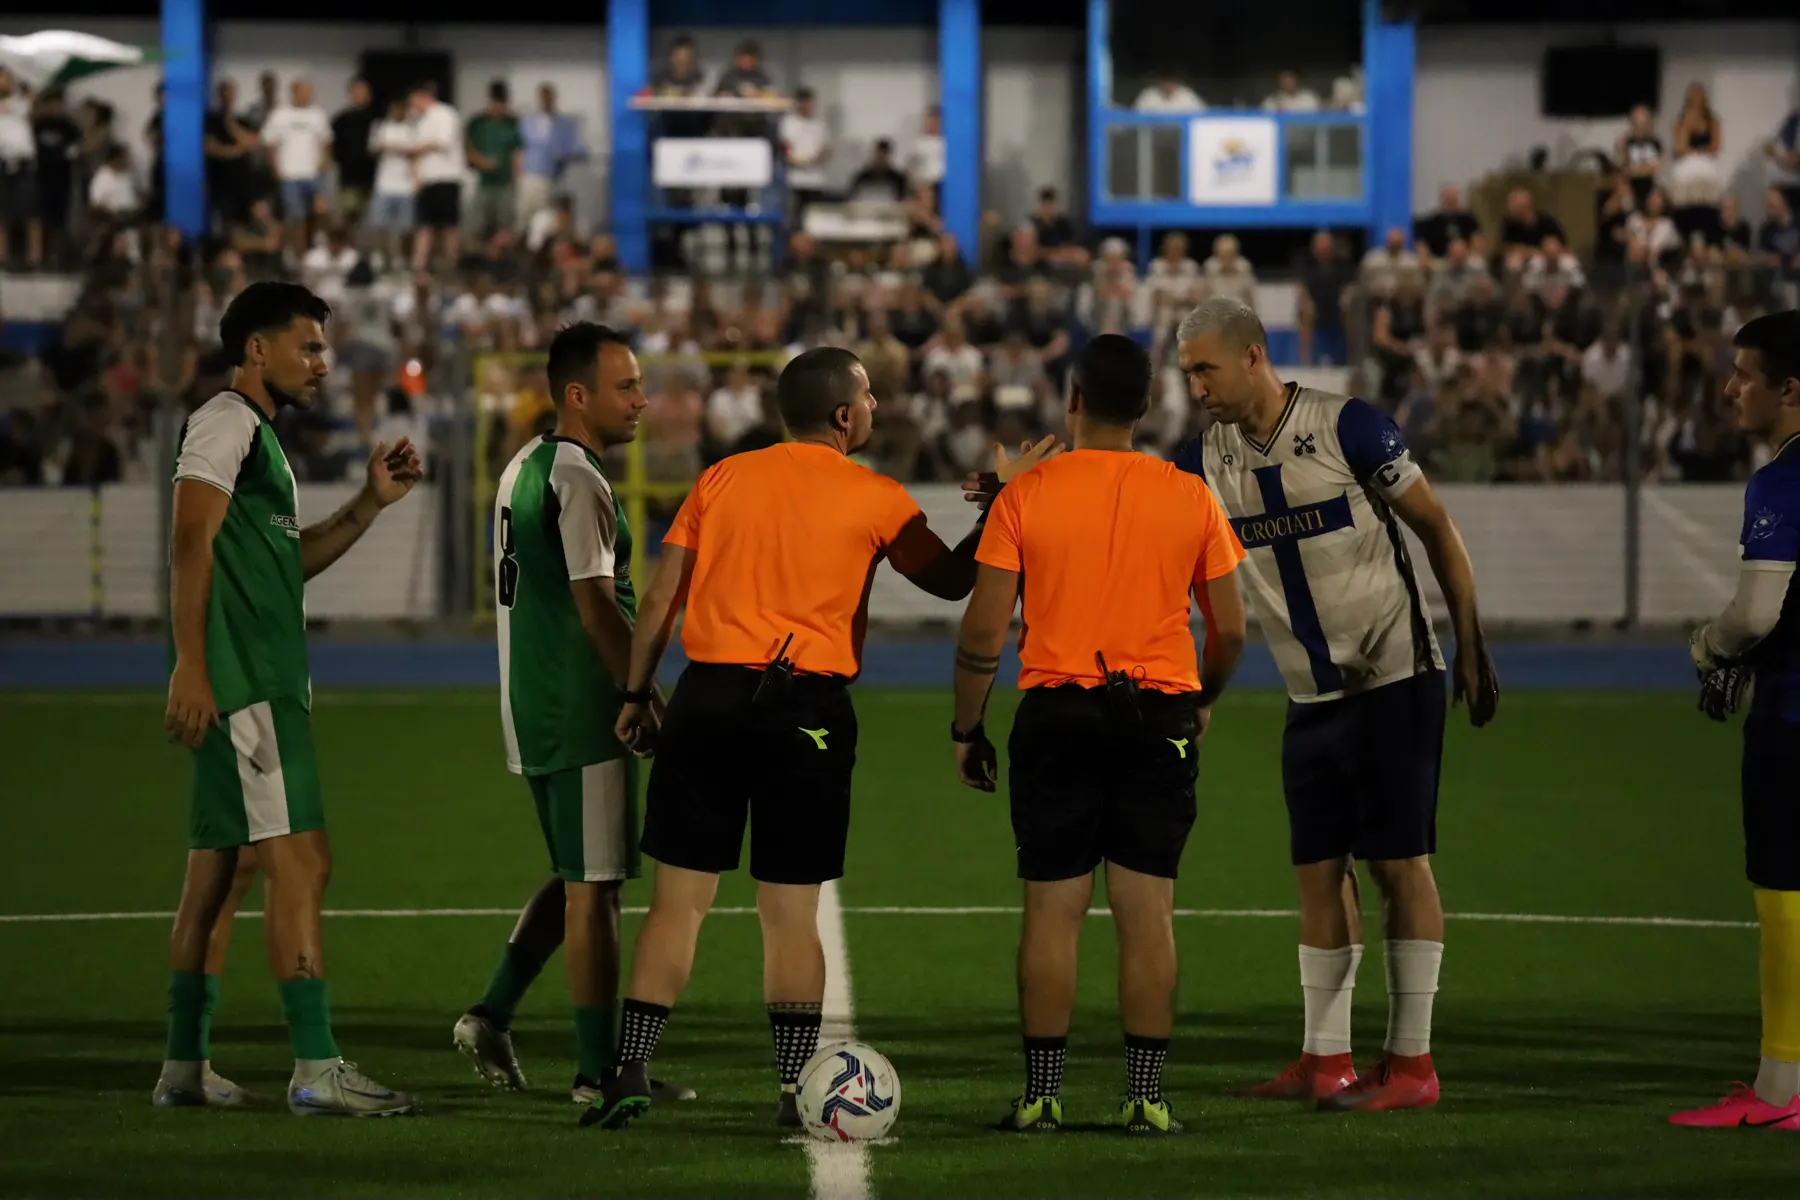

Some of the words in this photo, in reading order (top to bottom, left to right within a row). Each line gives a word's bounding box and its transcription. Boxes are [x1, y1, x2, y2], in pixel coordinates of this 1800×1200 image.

[1377, 464, 1400, 487] C
[1241, 510, 1324, 542] CROCIATI
[1130, 1124, 1150, 1132] COPA
